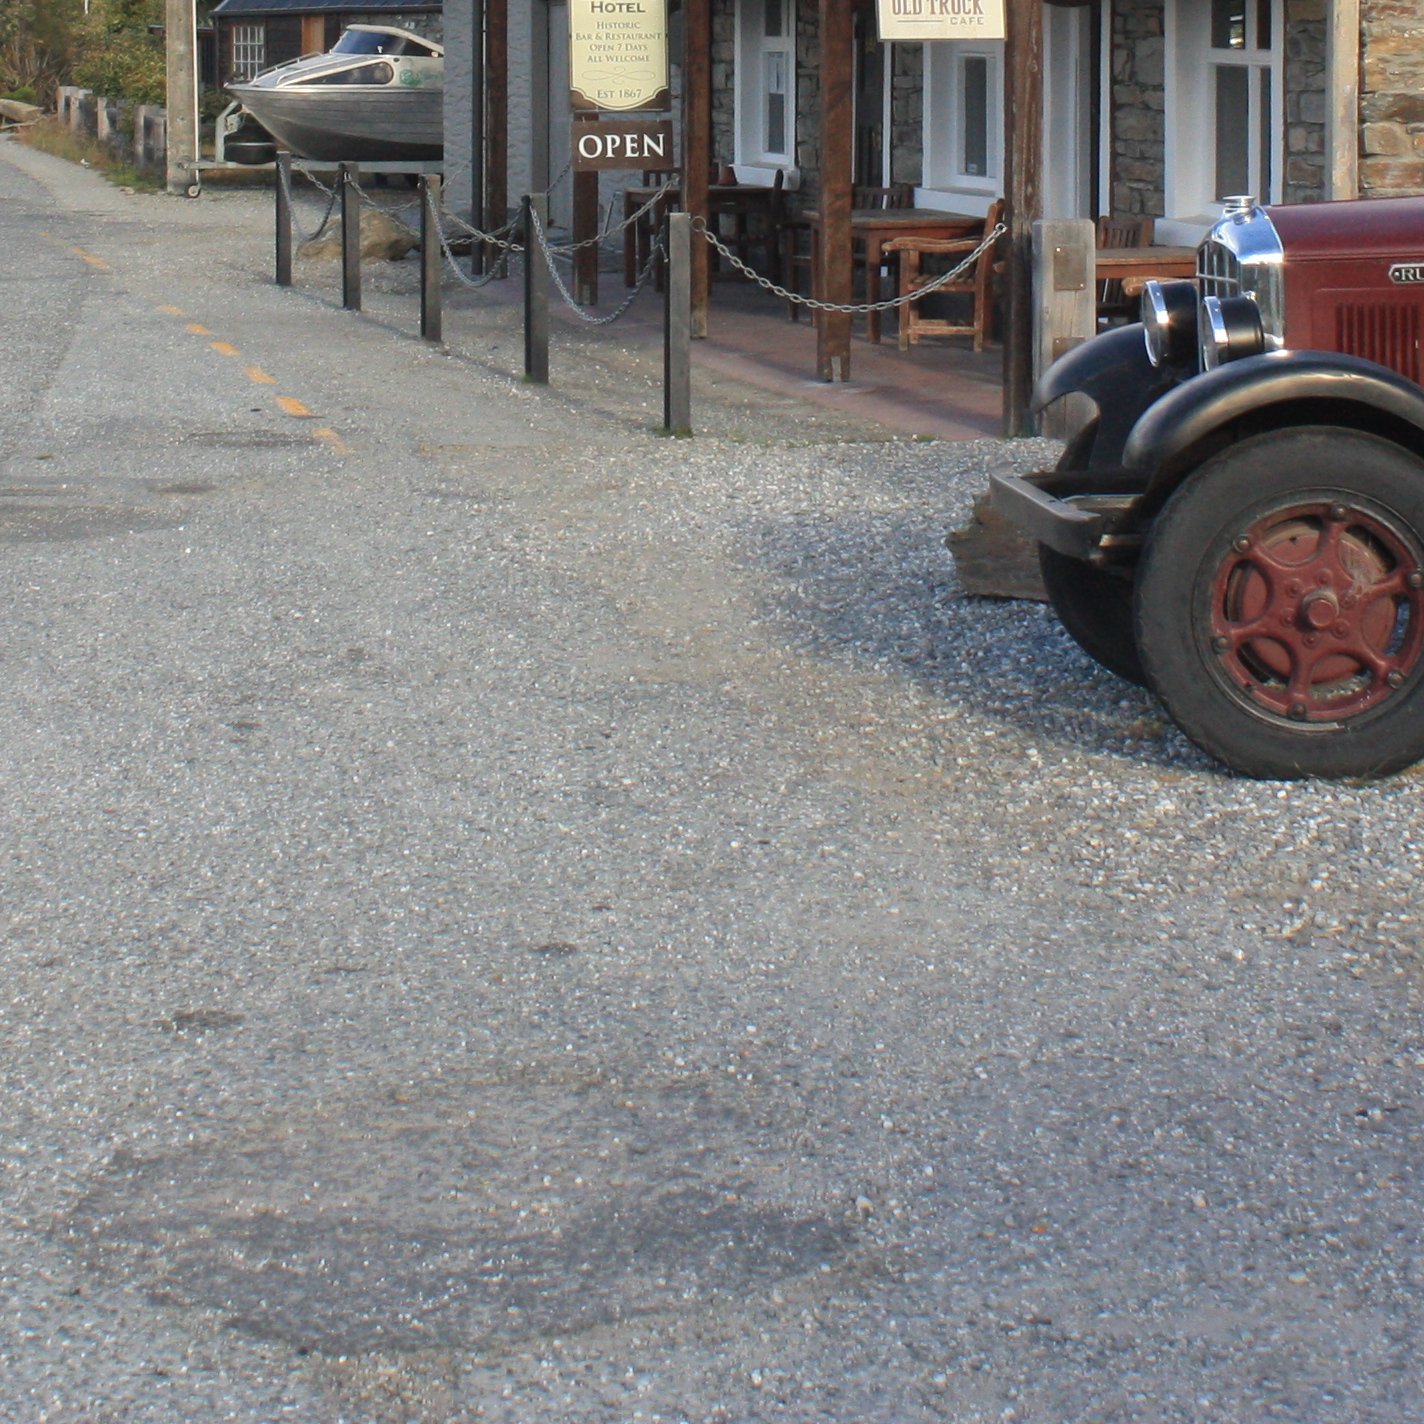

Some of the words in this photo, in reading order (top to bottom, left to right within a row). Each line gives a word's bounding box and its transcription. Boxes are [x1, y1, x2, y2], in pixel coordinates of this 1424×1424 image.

[590, 1, 646, 13] HOTEL
[597, 21, 640, 29] HISTORIC
[950, 16, 984, 25] CAFE
[576, 32, 593, 41] BAR
[595, 32, 603, 40] &
[605, 32, 661, 40] RESTAURANT
[590, 43, 614, 51] OPEN
[617, 43, 622, 51] 7
[625, 43, 648, 51] DAYS
[587, 55, 604, 63] ALL
[597, 89, 615, 99] EST
[619, 89, 642, 99] 1867
[578, 133, 665, 158] OPEN
